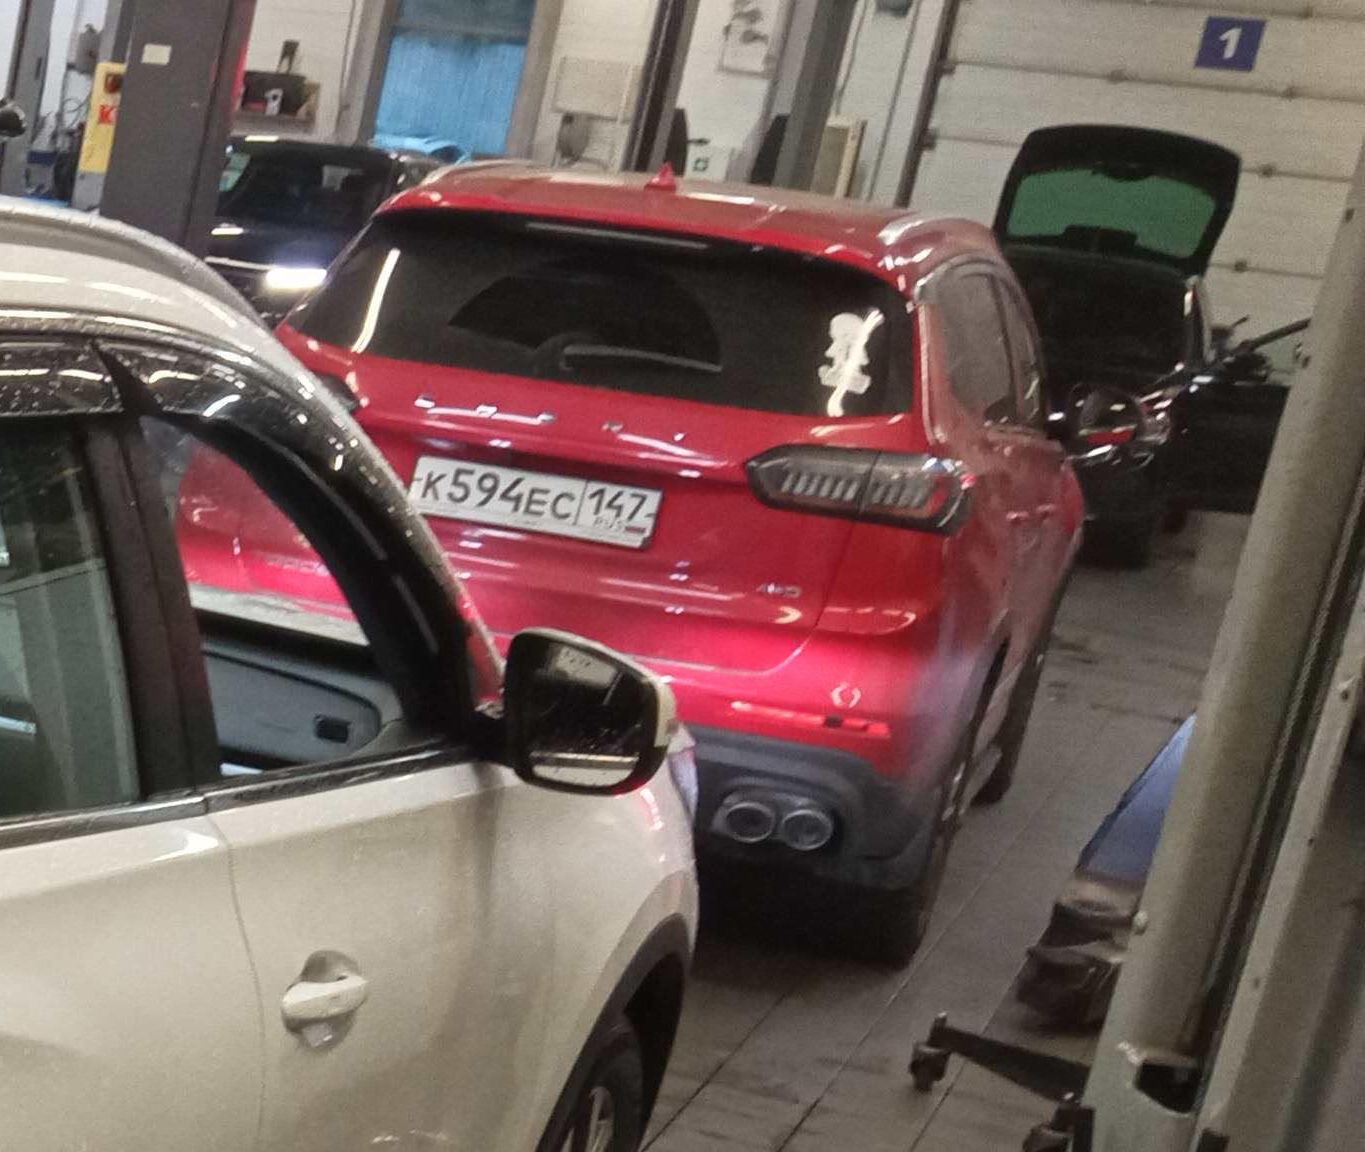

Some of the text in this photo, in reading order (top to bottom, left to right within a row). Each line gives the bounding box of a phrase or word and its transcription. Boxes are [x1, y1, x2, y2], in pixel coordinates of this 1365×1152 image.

[1219, 27, 1243, 60] 1
[421, 467, 648, 521] К594ЕС 147
